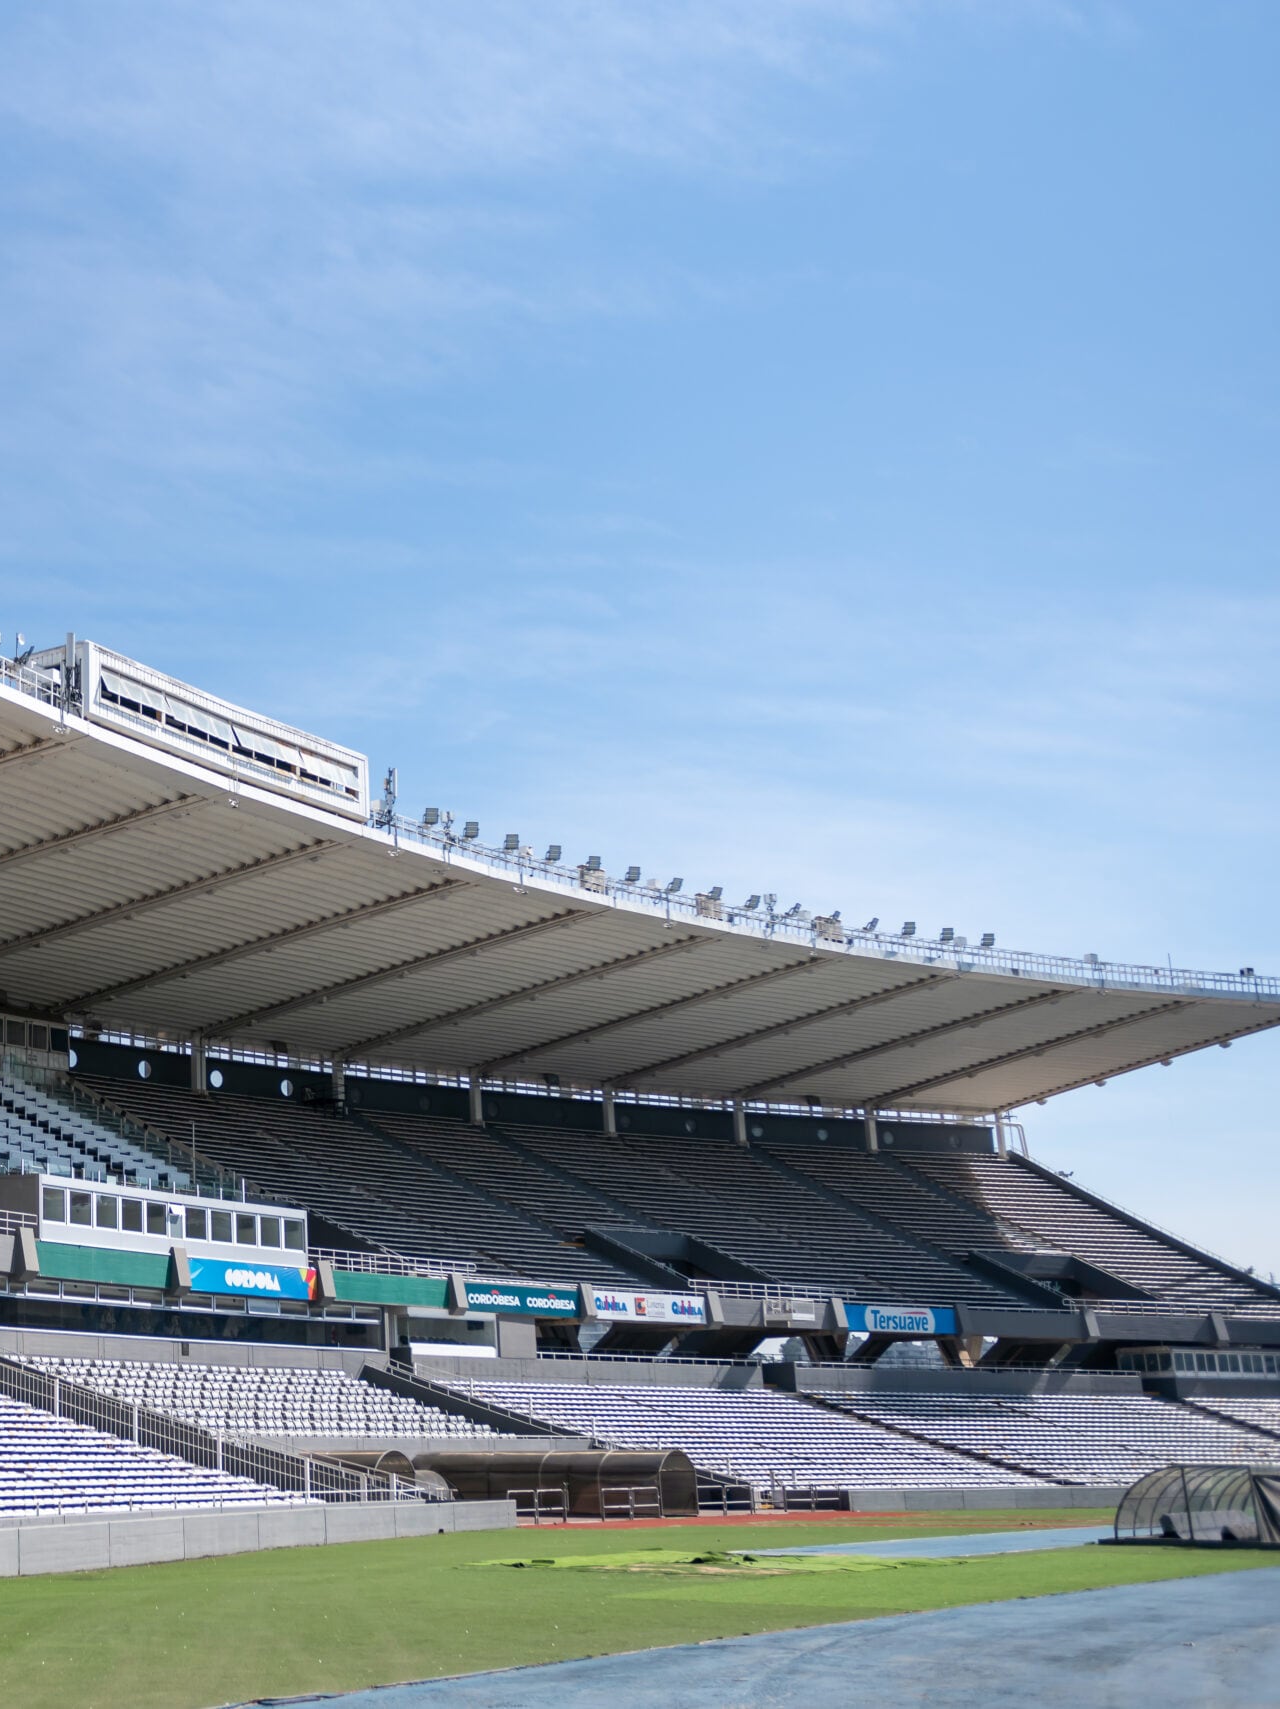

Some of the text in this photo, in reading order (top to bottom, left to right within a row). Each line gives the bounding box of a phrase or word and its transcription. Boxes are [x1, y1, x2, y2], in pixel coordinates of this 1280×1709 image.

[468, 1293, 521, 1306] CORDOBESA
[526, 1297, 576, 1310] CORDOBESA
[871, 1309, 928, 1331] Tersuave
